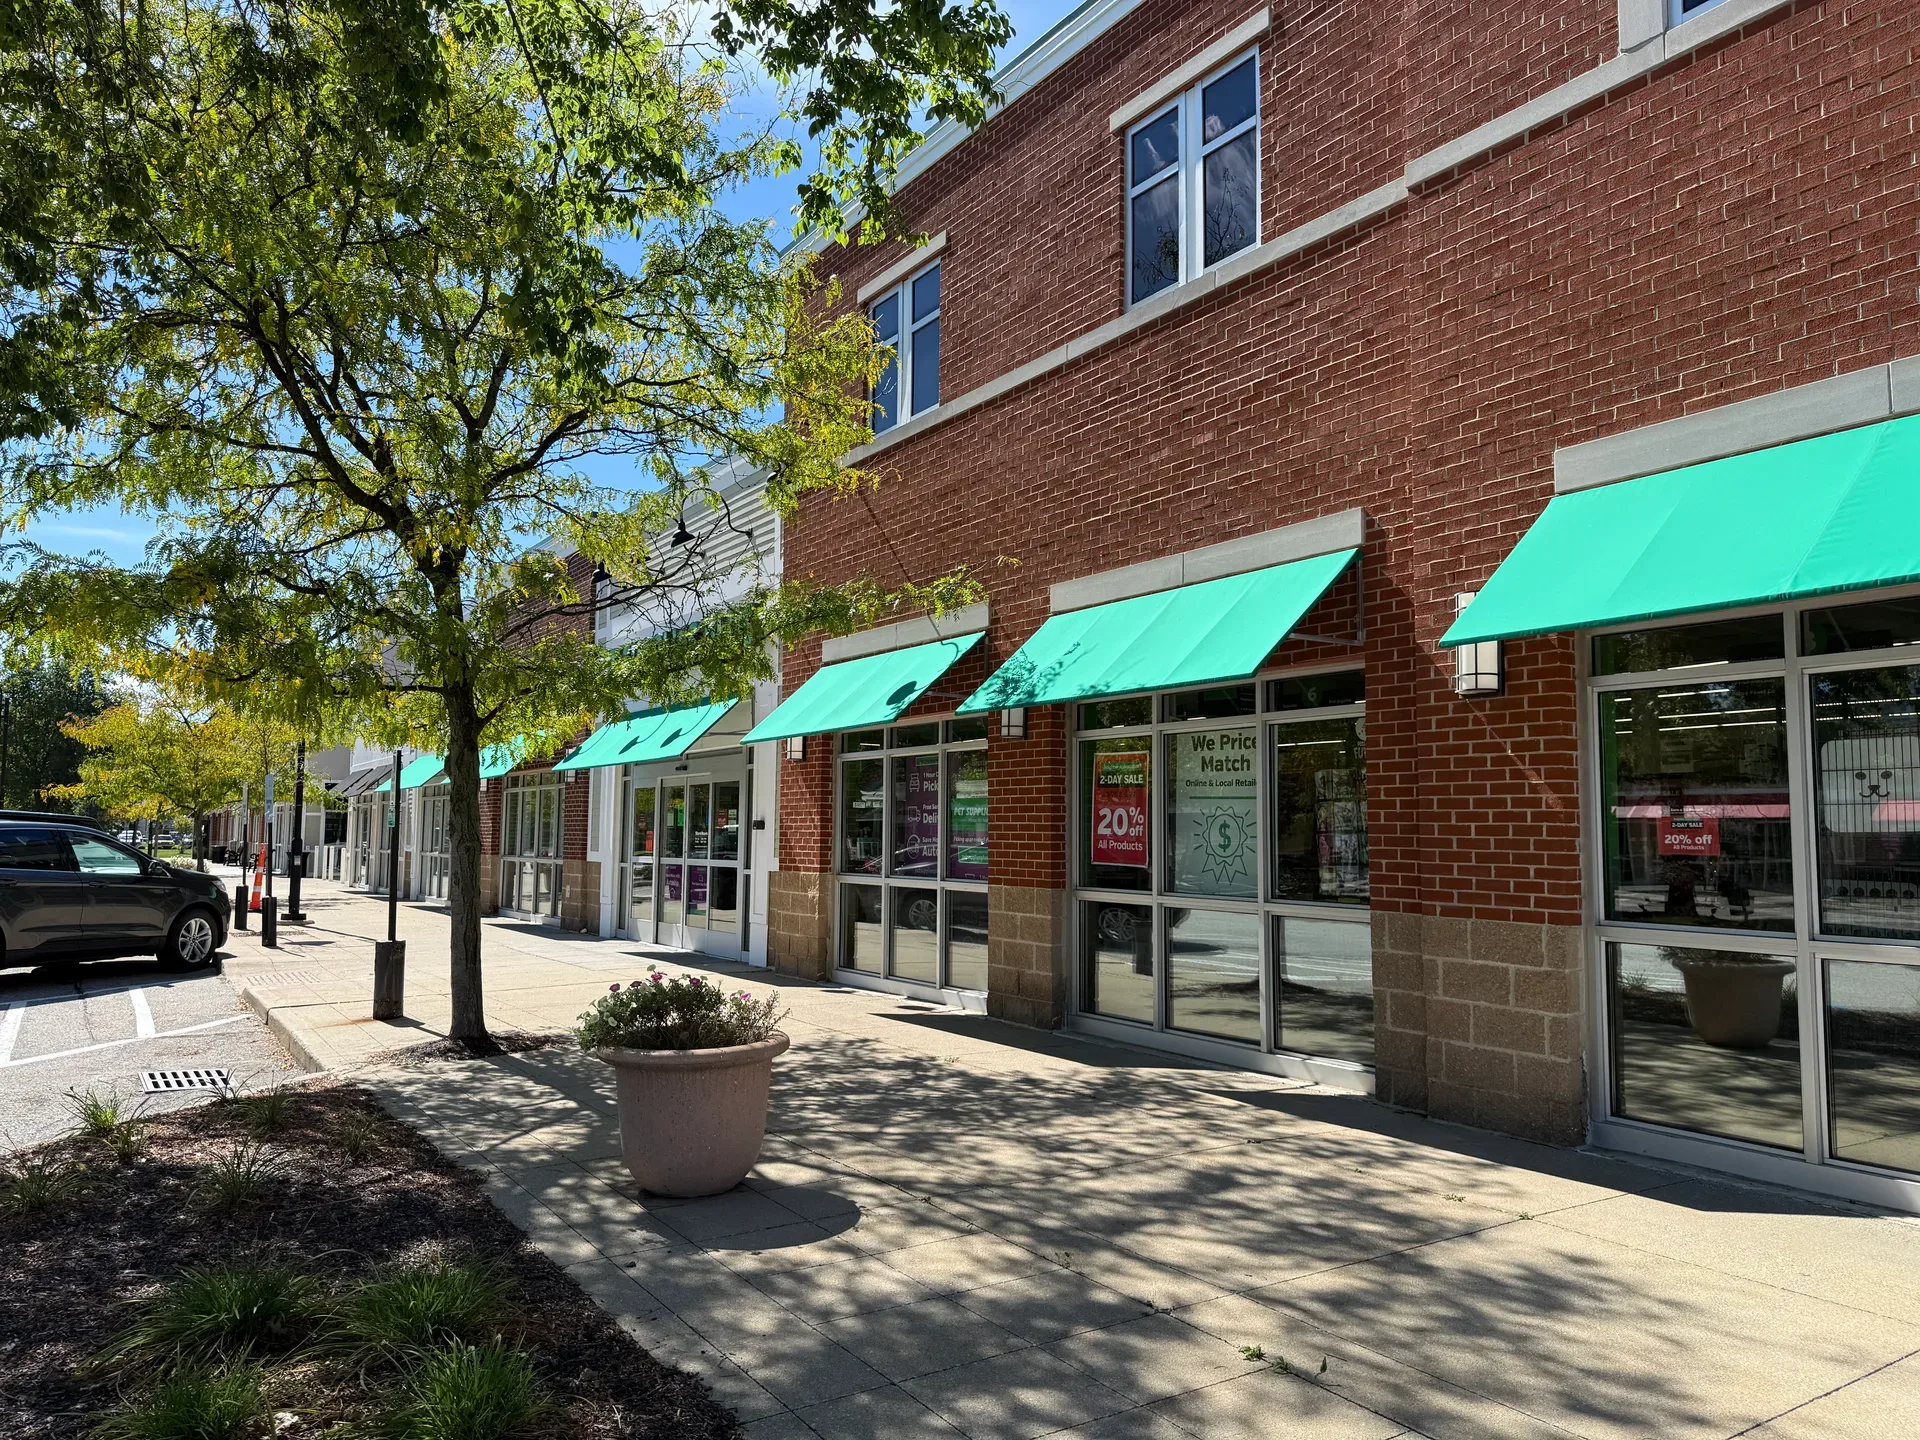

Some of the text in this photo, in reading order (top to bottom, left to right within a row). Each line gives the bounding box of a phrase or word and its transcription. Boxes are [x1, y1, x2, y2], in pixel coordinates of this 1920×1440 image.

[1191, 735, 1215, 751] We
[1201, 754, 1251, 772] Match
[1100, 774, 1144, 785] 2-DAY SALE
[1185, 779, 1207, 787] Online
[1208, 779, 1214, 787] &
[1215, 779, 1234, 787] Local
[953, 807, 965, 816] PET
[923, 812, 938, 823] Deli
[1097, 807, 1144, 836] 20%
[1129, 825, 1143, 836] off
[1664, 834, 1712, 845] 20% off
[1097, 840, 1143, 851] All Products
